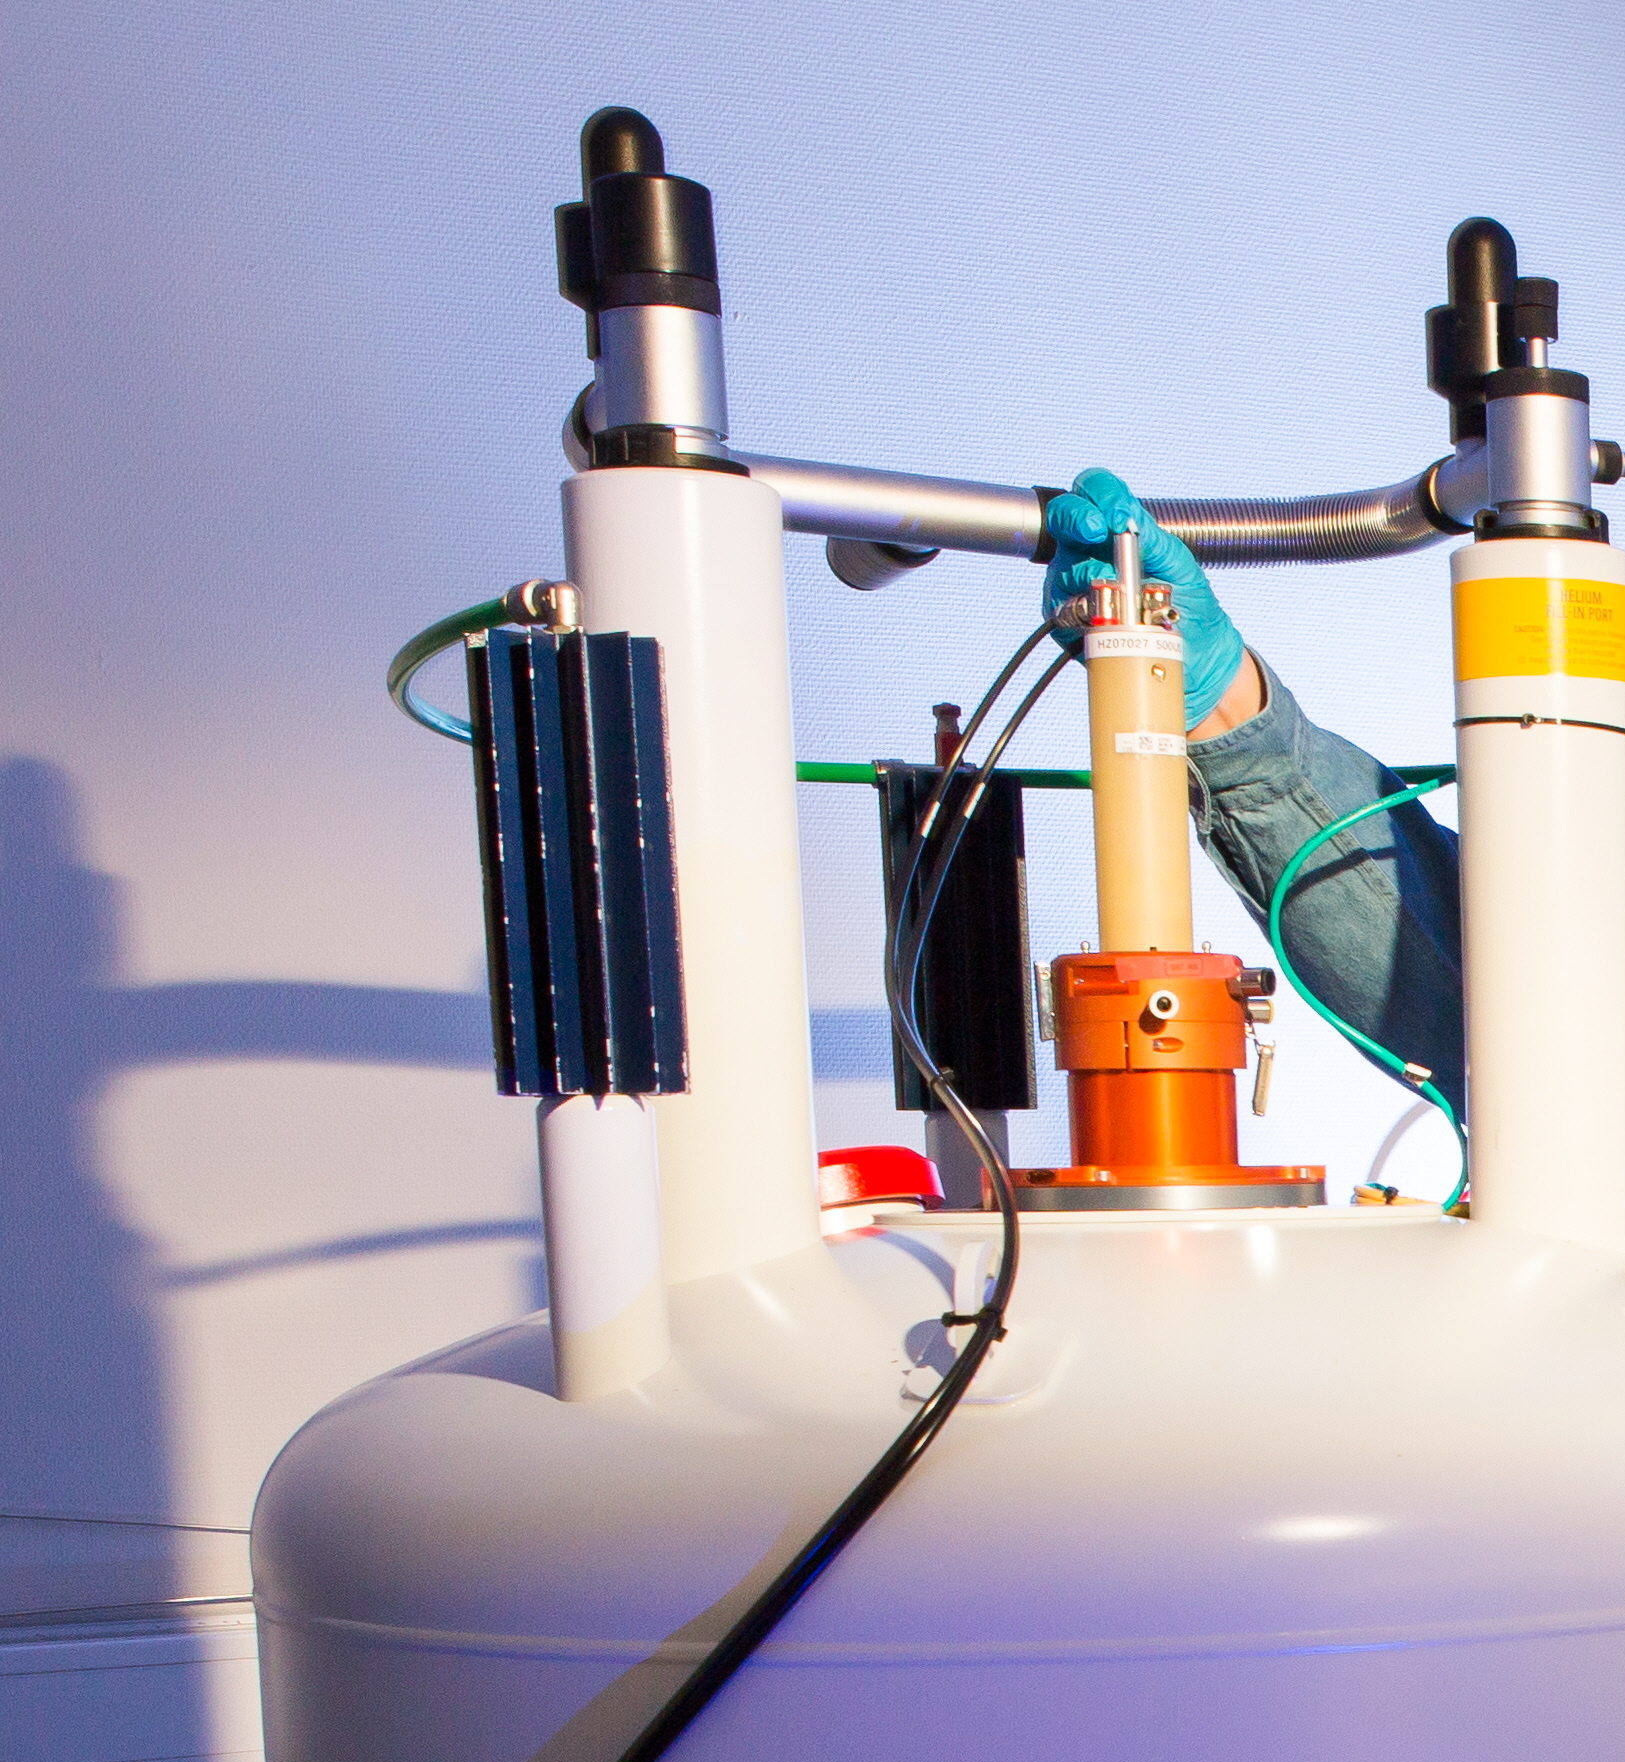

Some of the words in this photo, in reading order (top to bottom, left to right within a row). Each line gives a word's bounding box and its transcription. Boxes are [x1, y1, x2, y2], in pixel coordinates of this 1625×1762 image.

[1560, 589, 1602, 605] HELIUM
[1545, 605, 1585, 620] FILL-IN
[1589, 607, 1613, 622] PORT
[1097, 638, 1149, 649] HZ07027
